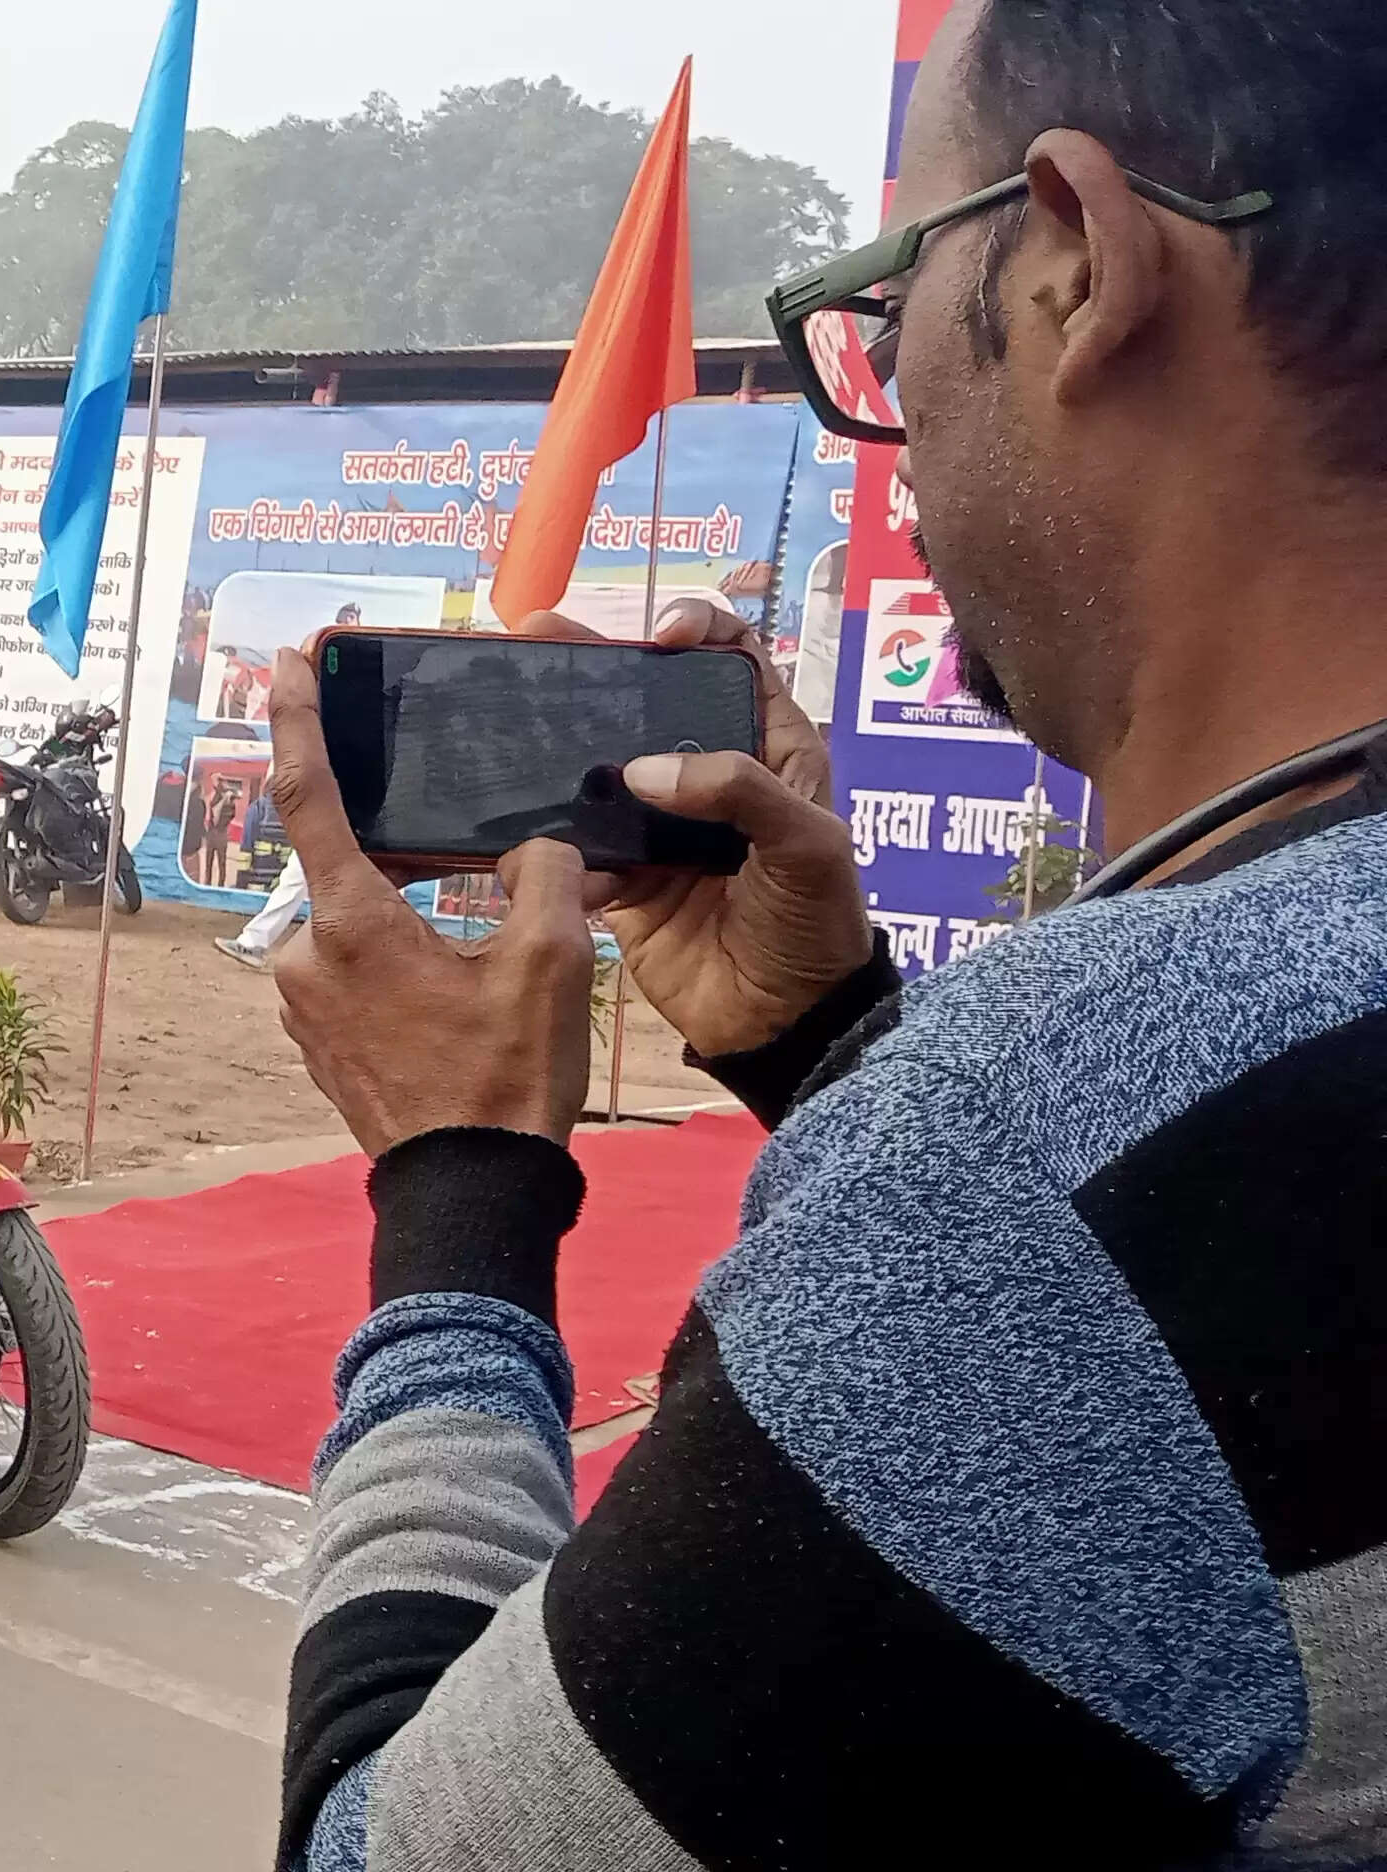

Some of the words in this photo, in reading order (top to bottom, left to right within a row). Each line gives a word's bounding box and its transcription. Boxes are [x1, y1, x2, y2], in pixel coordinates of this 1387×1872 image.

[0, 521, 41, 534] आपक
[210, 508, 249, 542] एक
[341, 511, 392, 544] आग
[392, 501, 460, 546] लगती
[850, 789, 936, 867] सुरक्षा
